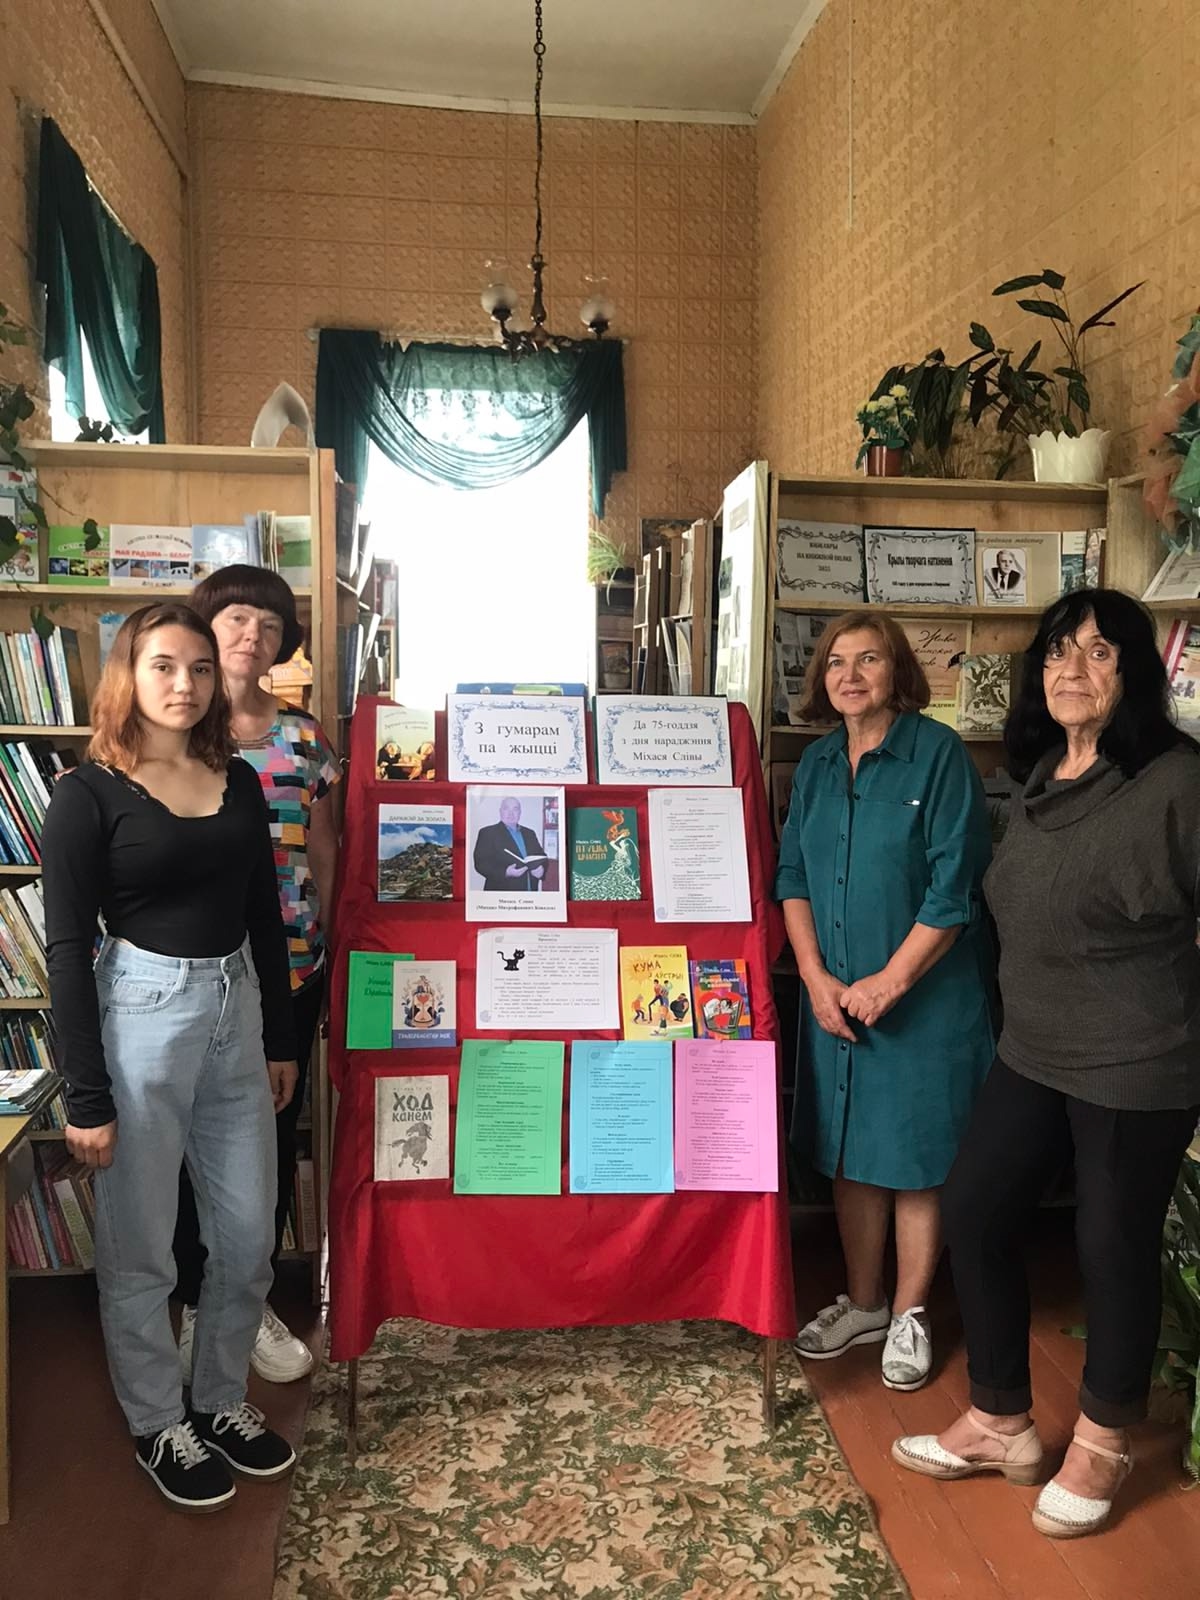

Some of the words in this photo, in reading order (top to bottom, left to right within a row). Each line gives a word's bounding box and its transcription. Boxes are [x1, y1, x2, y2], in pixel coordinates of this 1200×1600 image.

[474, 721, 484, 735] З
[497, 725, 560, 739] гумарам
[633, 720, 647, 730] Да
[652, 720, 699, 730] 75-годдзя
[479, 743, 496, 754] па
[509, 741, 557, 755] жыцці
[654, 738, 712, 747] нараджэння
[633, 751, 668, 761] Міхася
[672, 751, 703, 761] Слівы
[632, 960, 662, 973] КУМА
[393, 1091, 434, 1112] ХОД
[392, 1108, 433, 1122] канём
